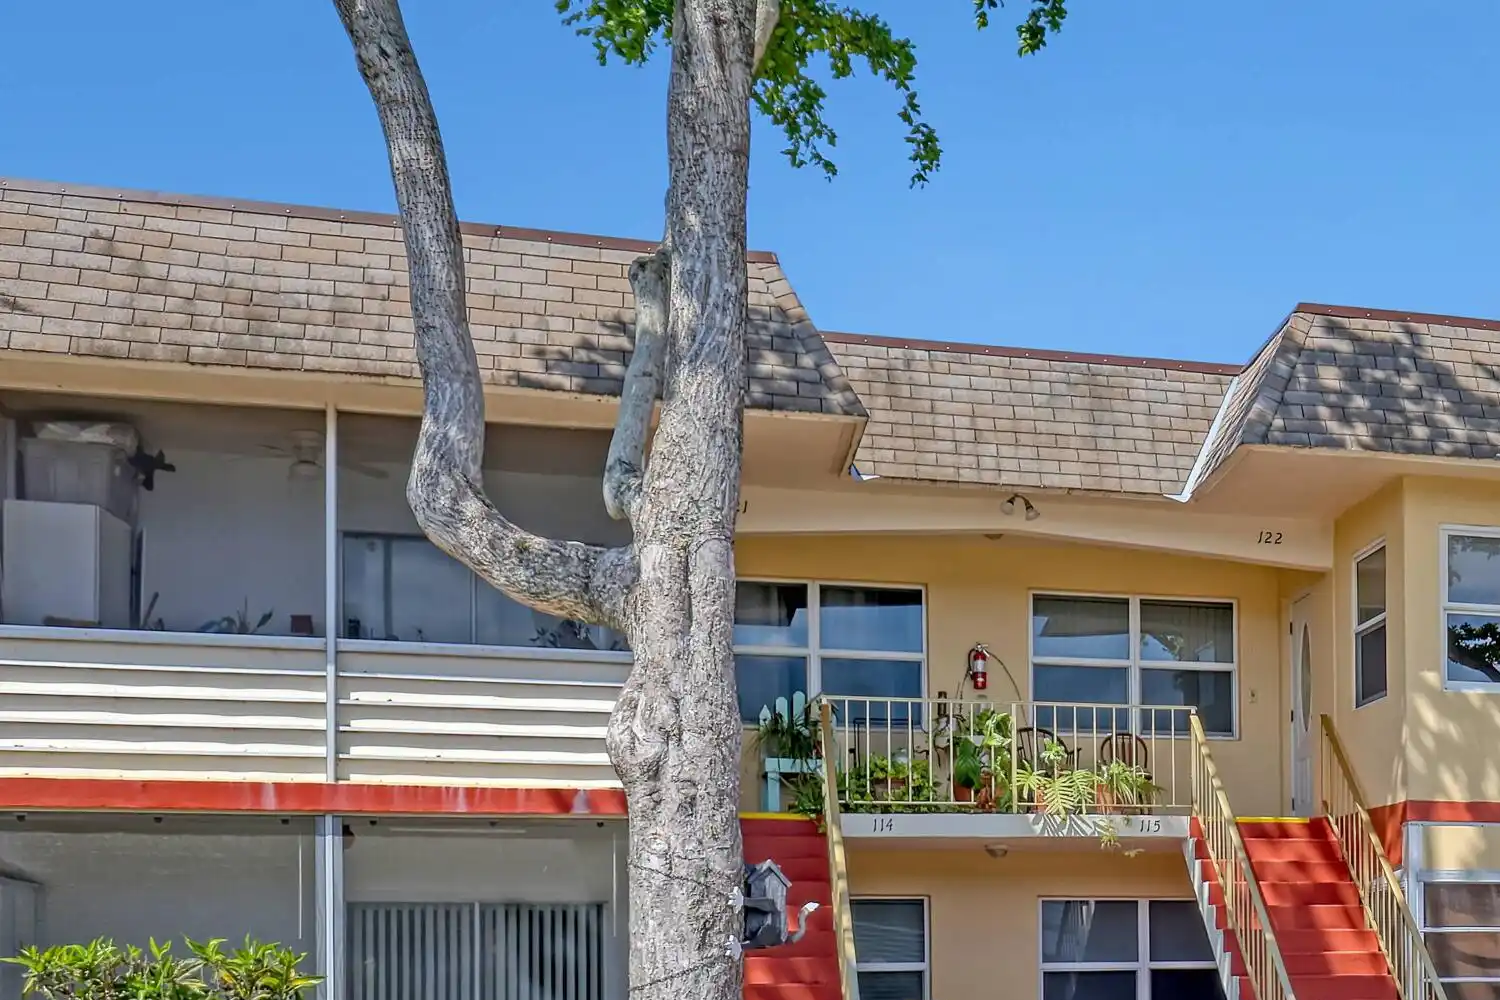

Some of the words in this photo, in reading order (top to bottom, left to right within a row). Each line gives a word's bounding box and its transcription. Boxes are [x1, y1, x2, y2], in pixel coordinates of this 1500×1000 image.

[1257, 531, 1283, 544] 122
[871, 818, 893, 832] 114
[1140, 819, 1161, 832] 115
